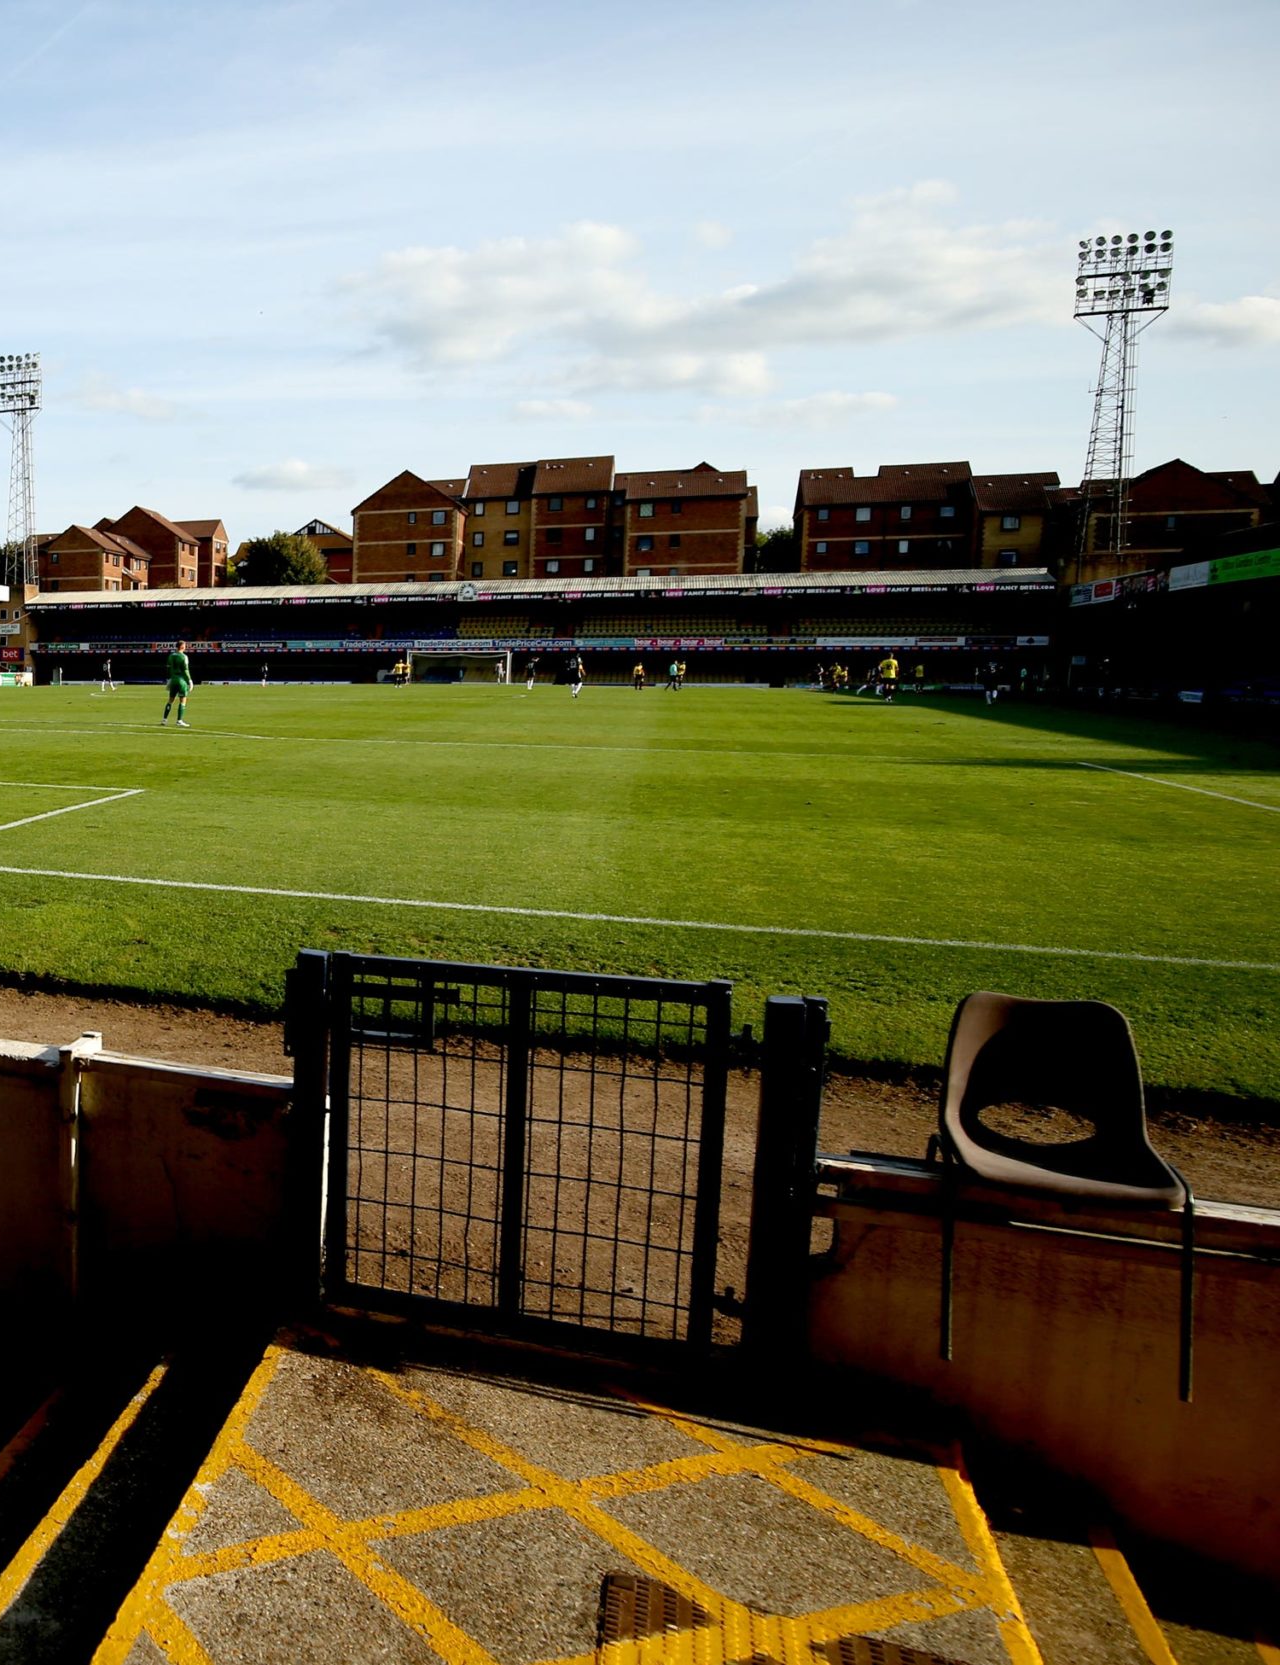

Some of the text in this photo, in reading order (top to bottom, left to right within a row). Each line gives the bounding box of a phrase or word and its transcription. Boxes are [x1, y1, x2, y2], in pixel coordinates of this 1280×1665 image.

[342, 640, 414, 648] TradePriceCars.com
[416, 640, 491, 648] TradePriceCars.com
[495, 639, 572, 647] TradePriceCars.com
[2, 650, 18, 658] bet
